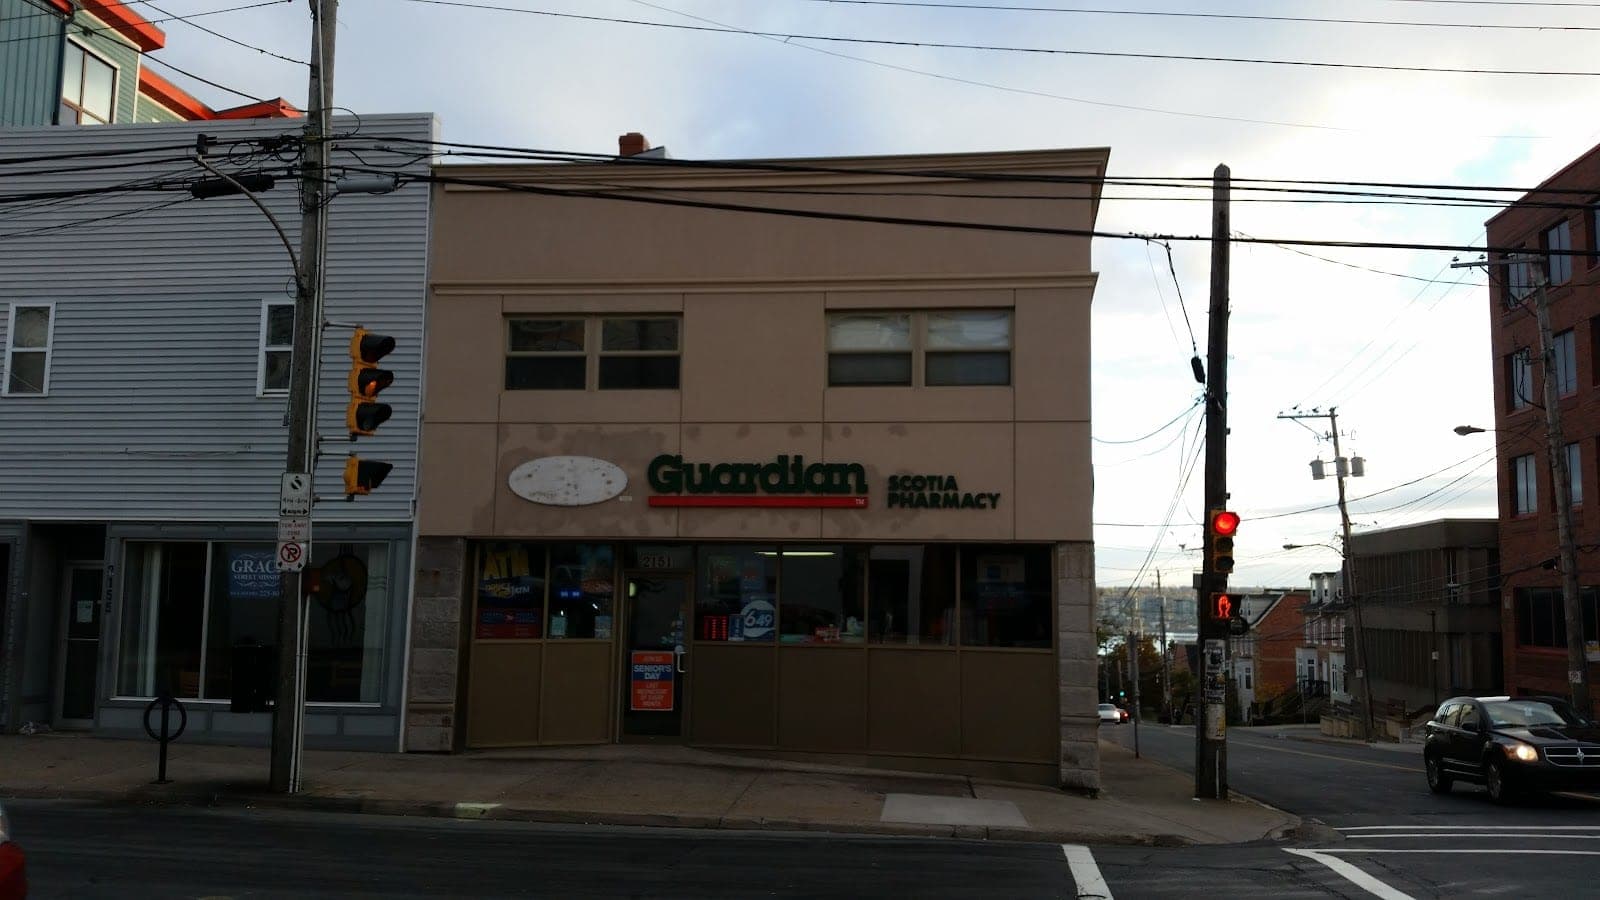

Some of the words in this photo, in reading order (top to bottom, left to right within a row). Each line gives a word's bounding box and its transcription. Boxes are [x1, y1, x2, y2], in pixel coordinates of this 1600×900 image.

[648, 454, 868, 494] Guardian
[888, 475, 958, 492] SCOTIA
[887, 492, 1001, 509] PHARMACY
[231, 559, 280, 574] GRAC
[643, 556, 672, 568] 2151
